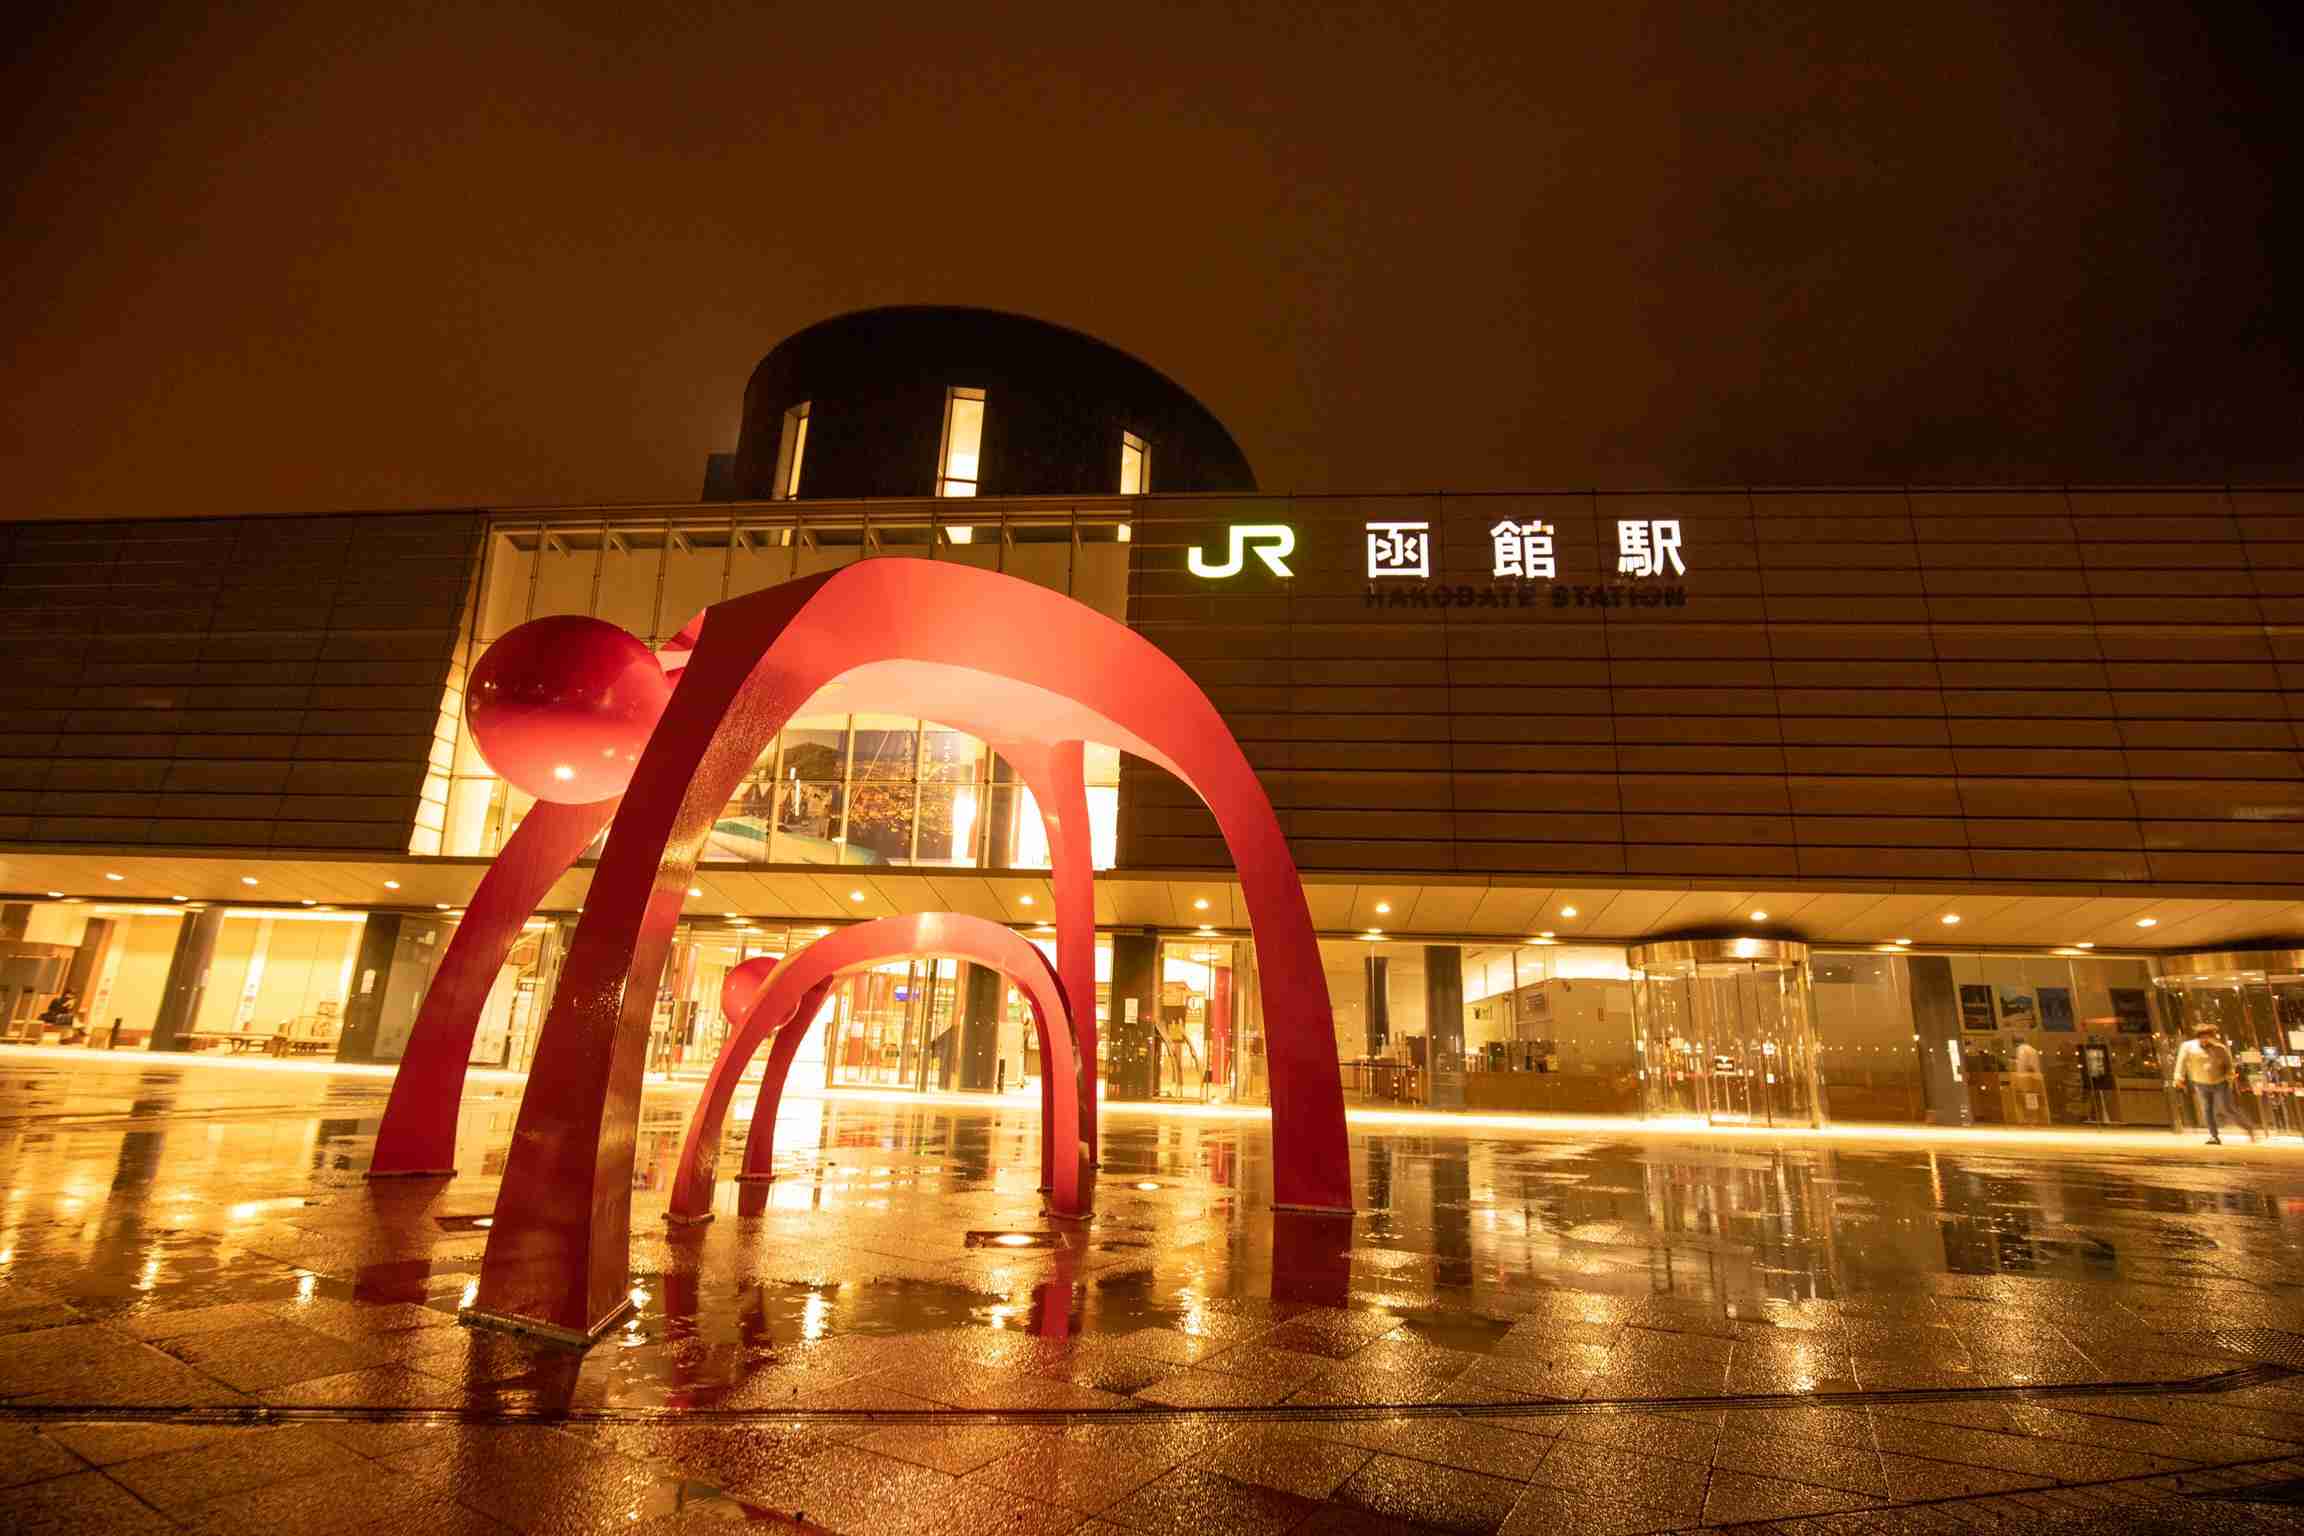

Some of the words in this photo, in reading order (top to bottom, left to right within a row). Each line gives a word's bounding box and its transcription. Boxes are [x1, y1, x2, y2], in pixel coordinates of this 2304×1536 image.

[1187, 524, 1296, 578] JR
[1365, 520, 1686, 579] 函館駅
[1551, 585, 1686, 608] STATION
